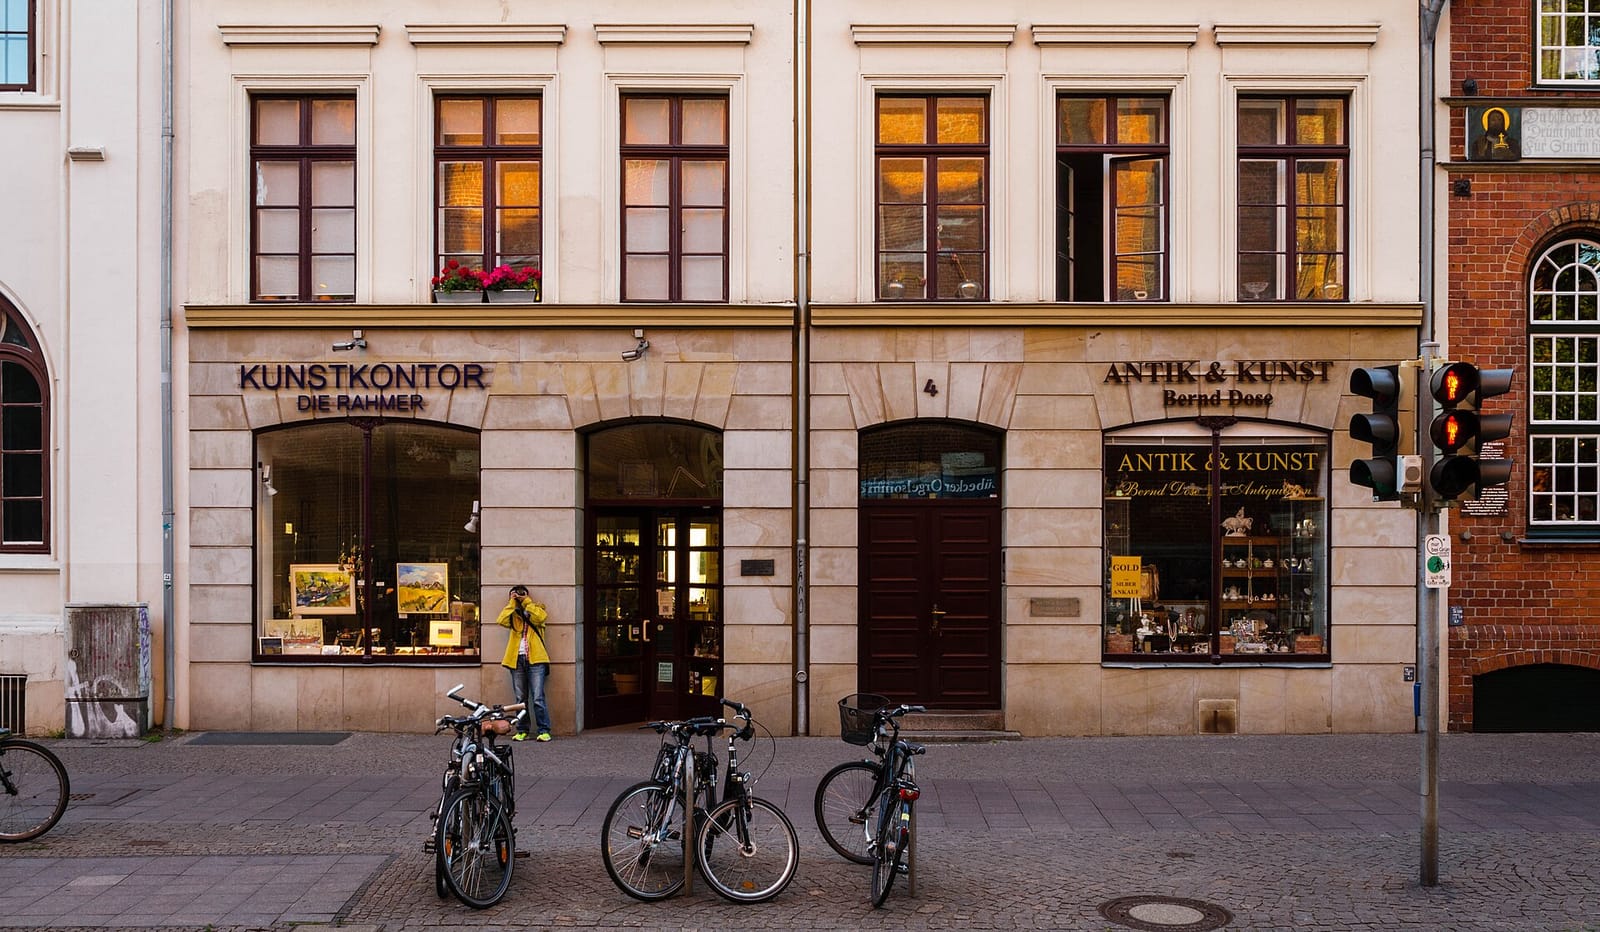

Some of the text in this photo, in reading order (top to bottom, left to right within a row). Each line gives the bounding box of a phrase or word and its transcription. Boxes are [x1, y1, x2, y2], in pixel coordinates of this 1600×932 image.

[240, 363, 486, 390] KUNSTKONTOR
[1104, 361, 1334, 384] ANTIK & KUNST
[923, 378, 938, 397] 4
[297, 394, 424, 411] DIE RAHMER
[1163, 389, 1274, 408] Bernd Dose
[1117, 452, 1319, 472] ANTIK & KUNST
[1119, 480, 1168, 497] Bernd
[1169, 480, 1200, 497] Dose
[1113, 564, 1139, 572] GOLD
